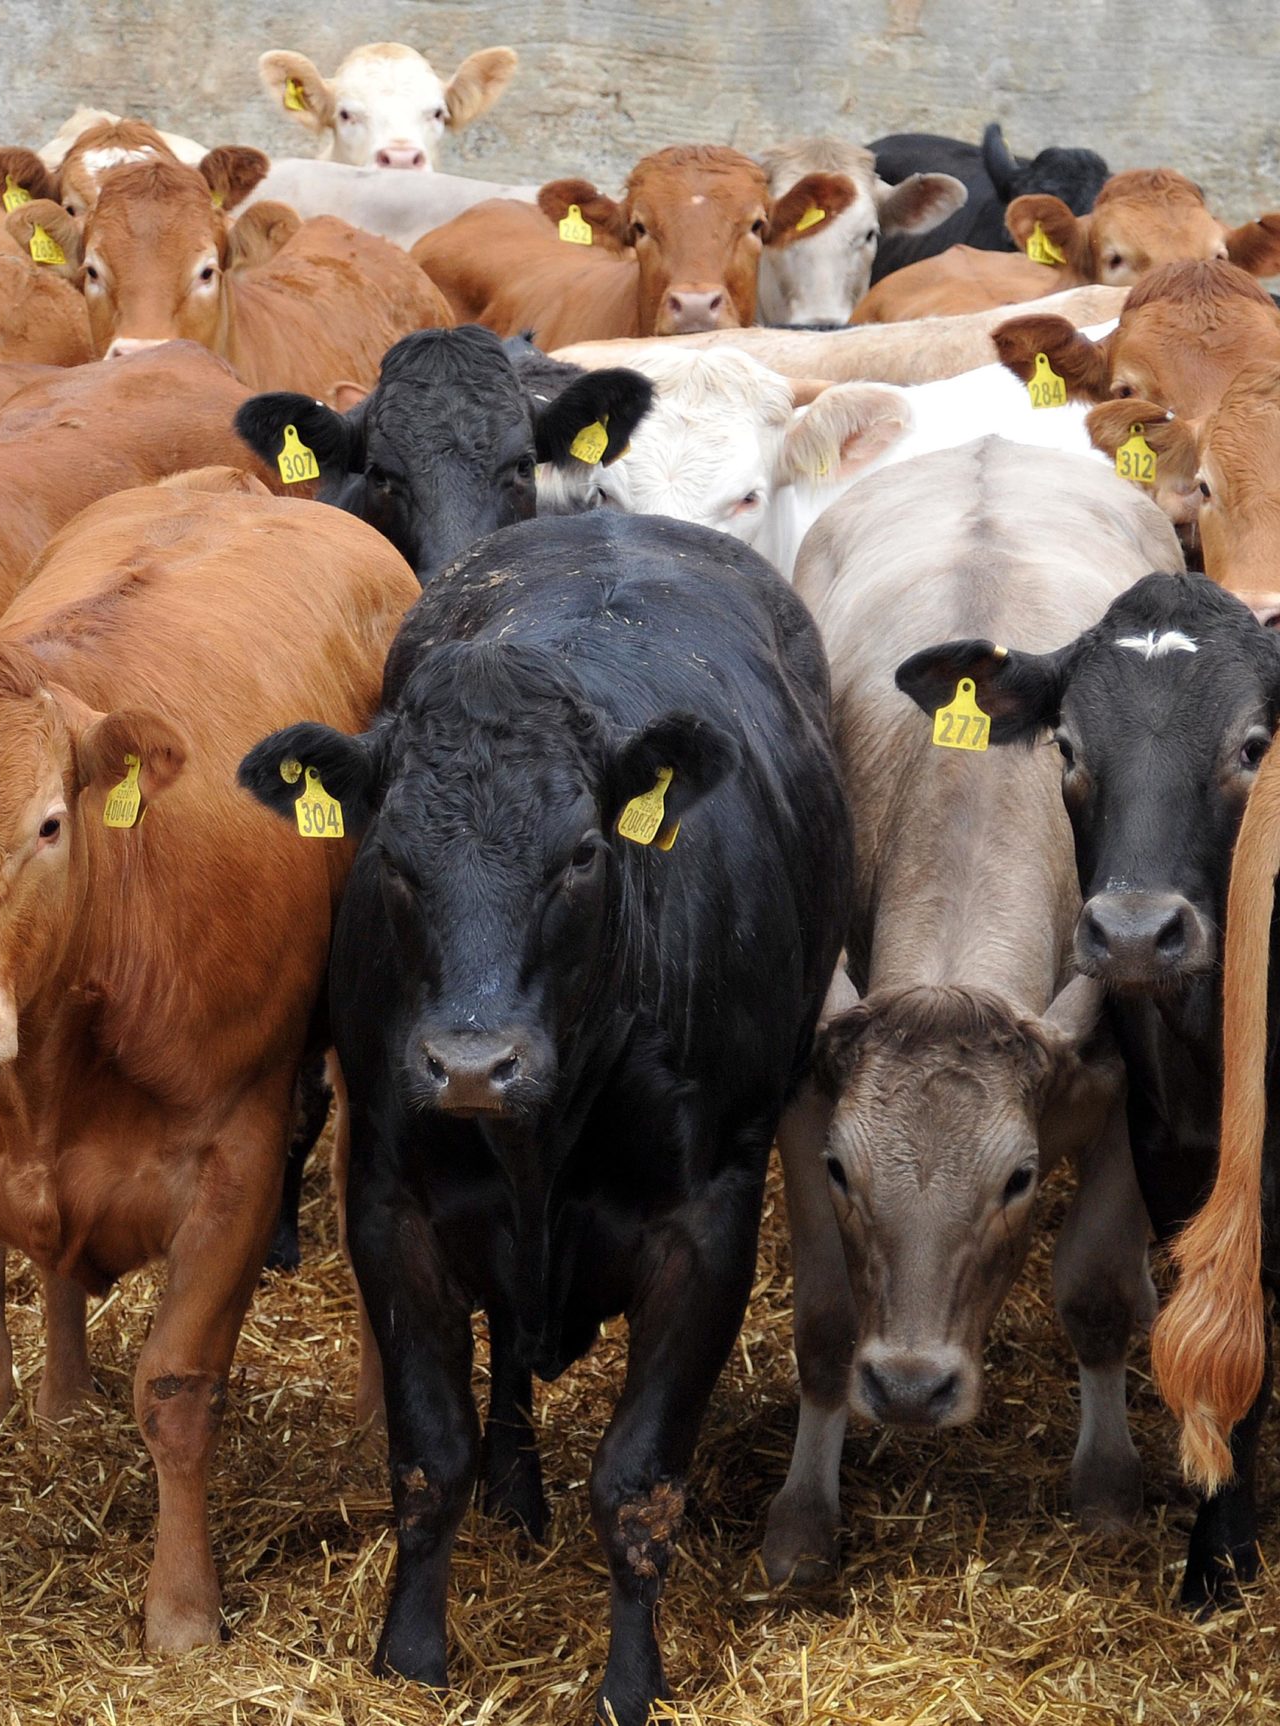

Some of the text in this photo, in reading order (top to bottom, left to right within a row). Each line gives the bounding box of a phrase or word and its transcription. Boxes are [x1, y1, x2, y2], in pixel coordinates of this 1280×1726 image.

[563, 222, 588, 242] 262
[1032, 380, 1063, 407] 284
[283, 451, 313, 481] 307
[1120, 450, 1153, 479] 312
[938, 712, 987, 746] 277
[301, 802, 340, 835] 304
